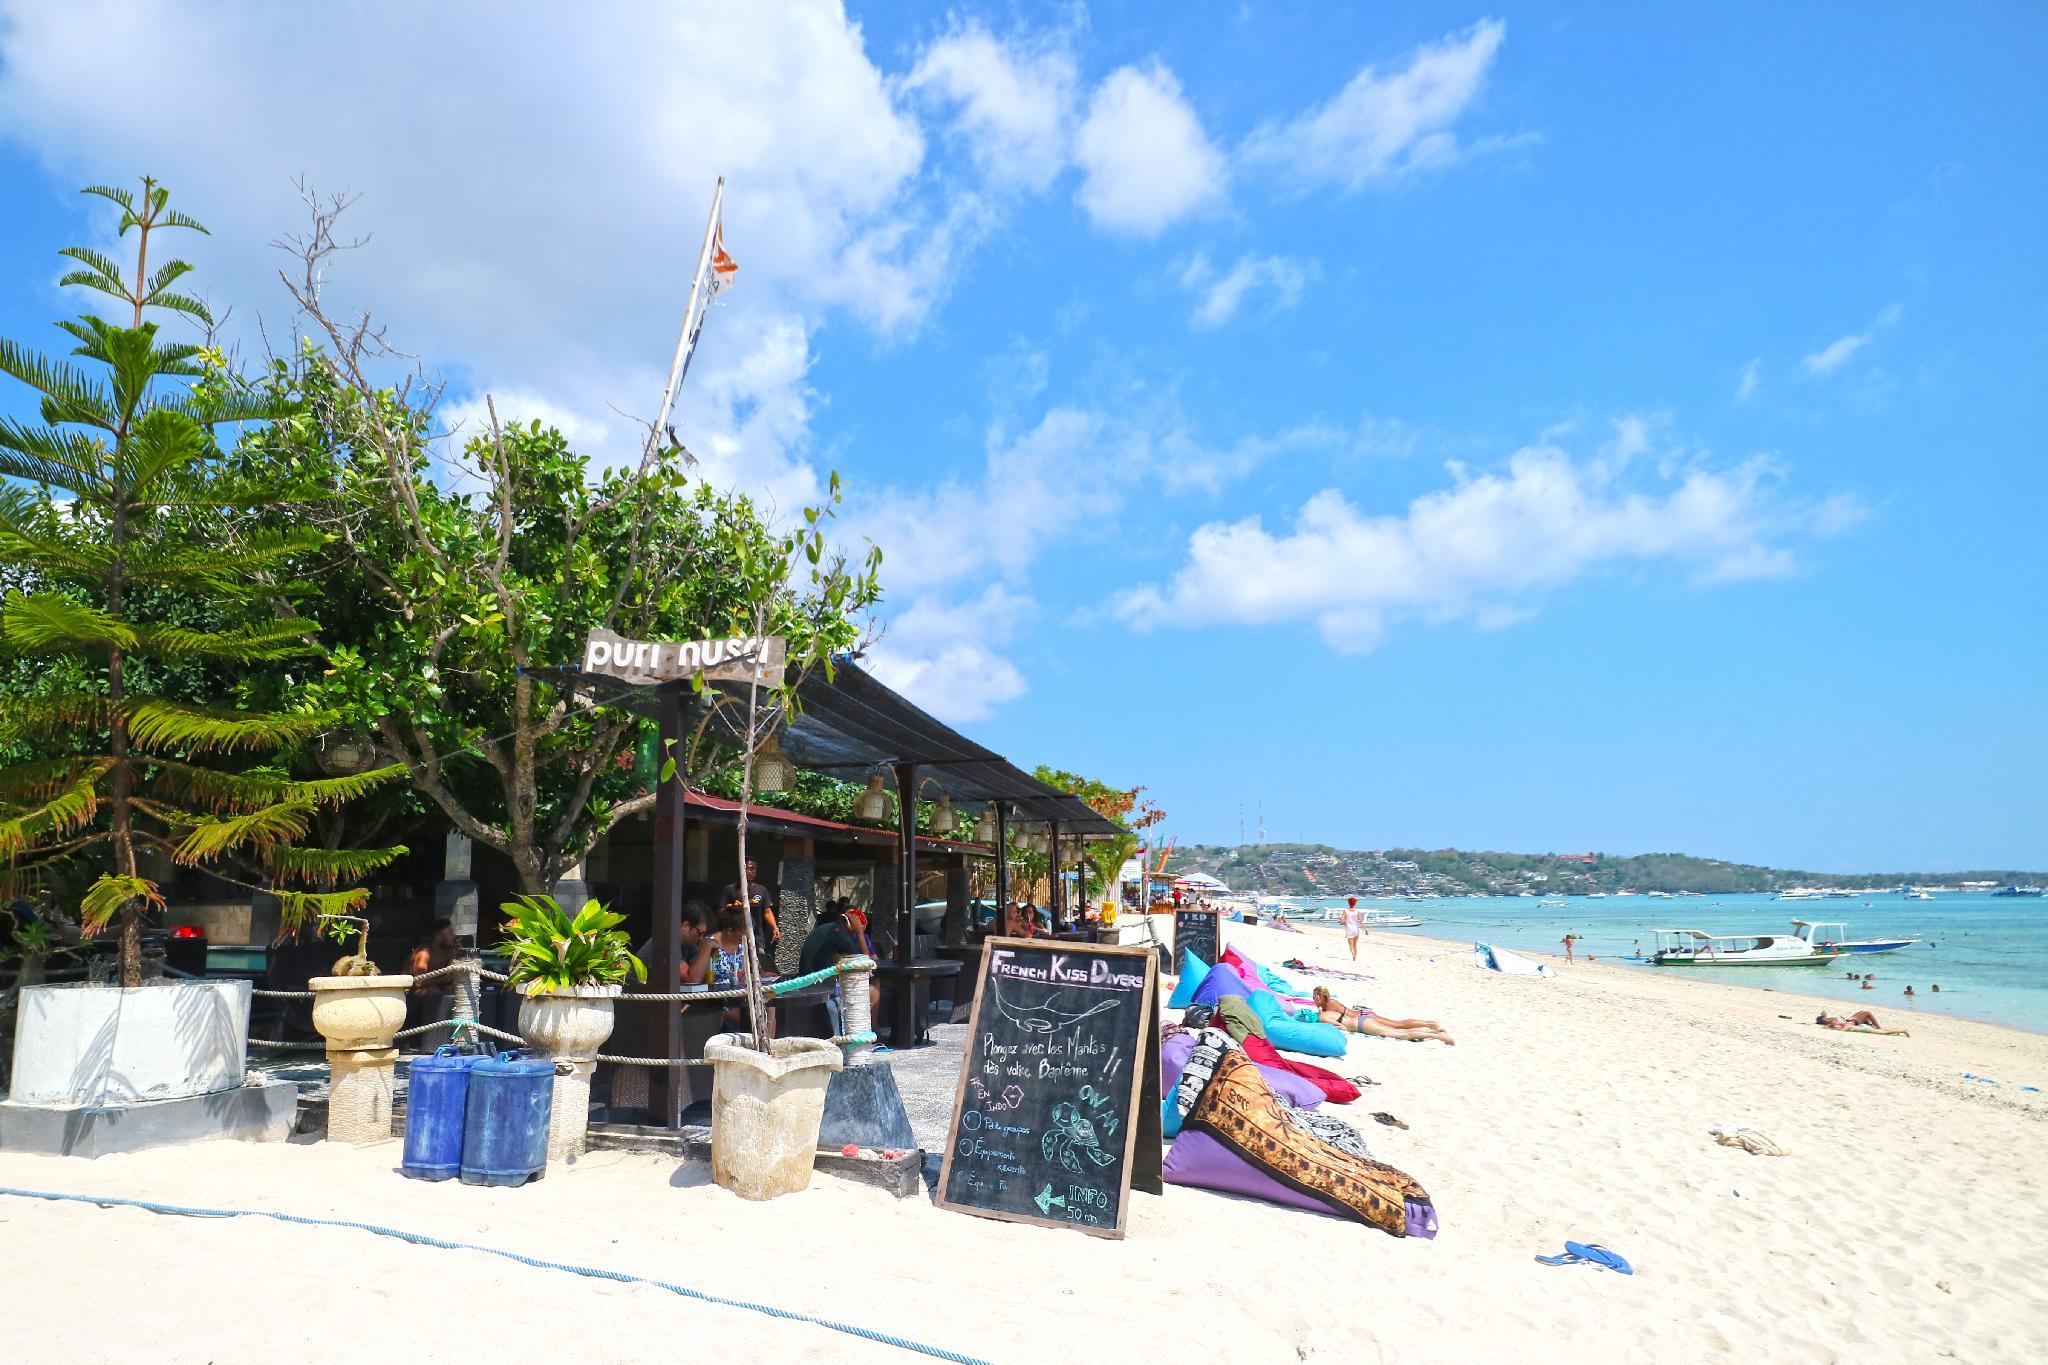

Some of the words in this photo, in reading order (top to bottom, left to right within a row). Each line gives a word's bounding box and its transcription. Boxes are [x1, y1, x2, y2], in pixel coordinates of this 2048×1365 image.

[585, 641, 661, 673] puri
[677, 638, 769, 666] nusa
[983, 1032, 1018, 1062] Plongez
[1022, 1043, 1044, 1055] avec
[1048, 1033, 1063, 1055] les
[1067, 1025, 1106, 1061] Mantas
[983, 1059, 1000, 1075] dès
[1038, 1058, 1089, 1083] Baptême
[978, 1088, 990, 1099] EN
[1068, 1184, 1108, 1209] INFO
[1067, 1205, 1083, 1221] 50
